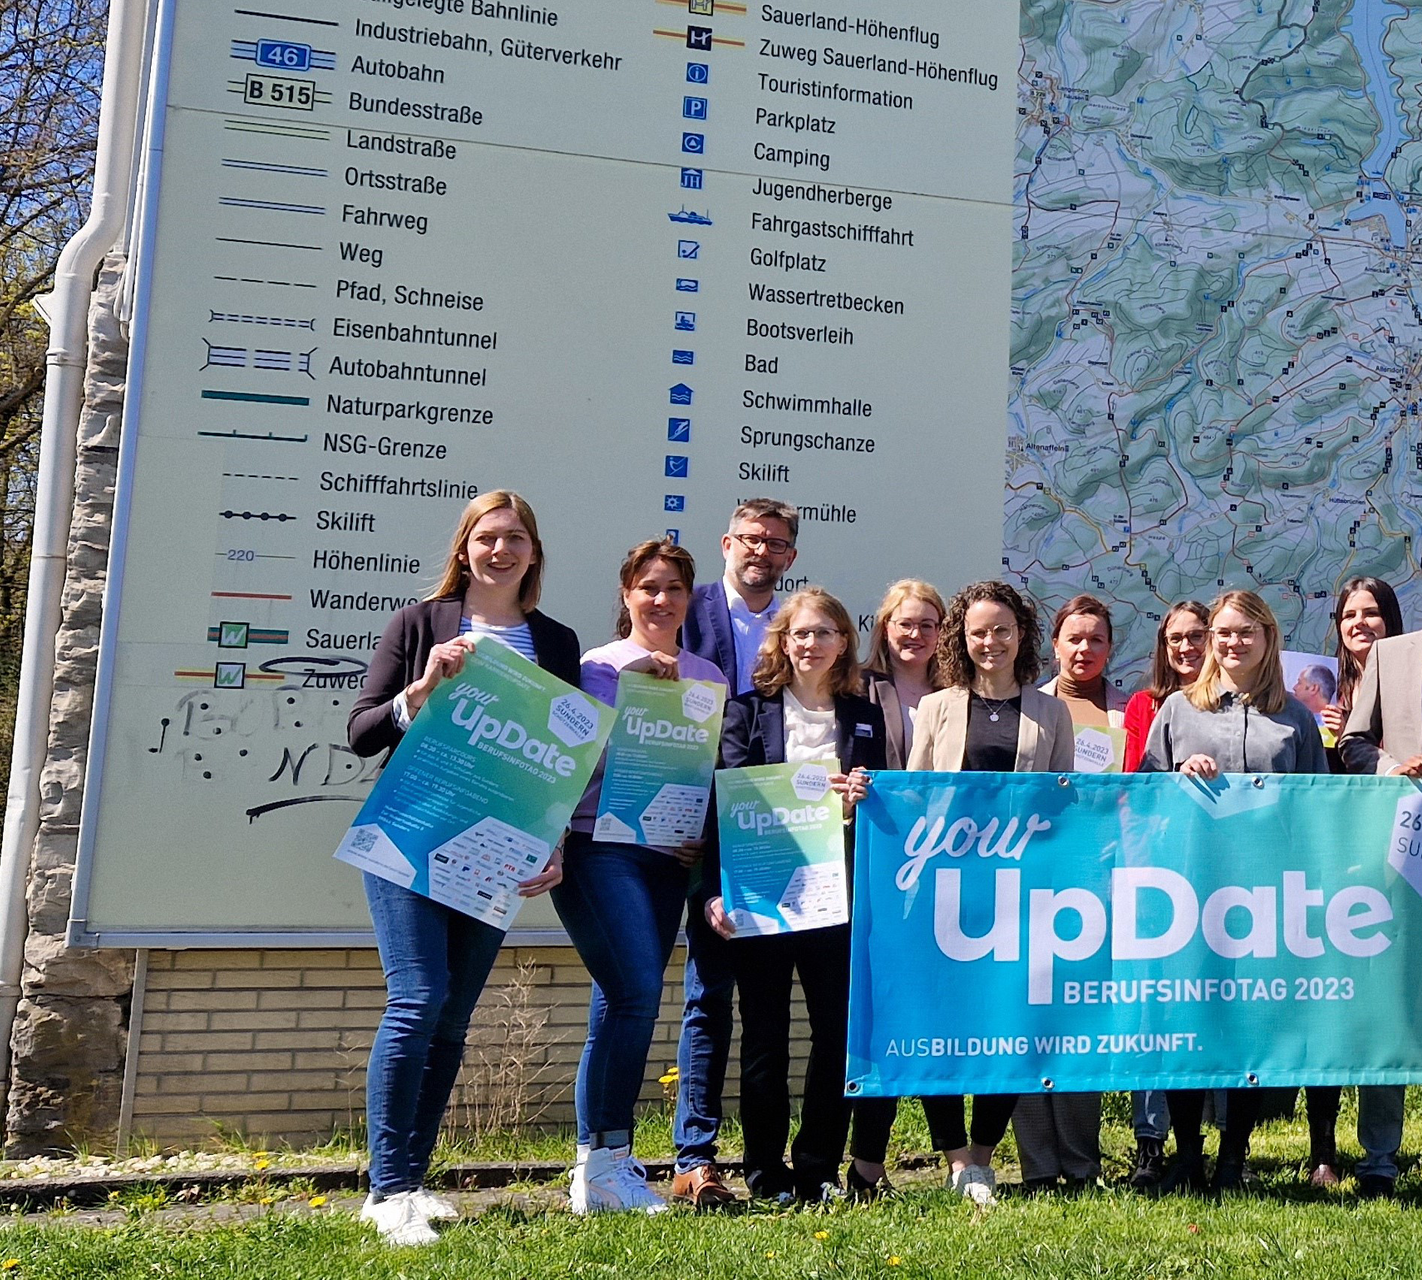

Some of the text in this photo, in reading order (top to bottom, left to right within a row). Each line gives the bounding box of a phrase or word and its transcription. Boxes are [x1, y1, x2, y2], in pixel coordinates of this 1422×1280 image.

[471, 0, 558, 27] Bahnlinie
[761, 5, 940, 49] Sauerland-Höhenflug
[267, 48, 298, 67] 46
[355, 18, 622, 72] Industriebahn, Güterverkehr
[351, 55, 445, 85] Autobahn
[759, 39, 998, 89] Zuweg Sauerland-Höhenflug
[249, 81, 311, 105] B 515
[758, 73, 913, 110] Touristinformation
[349, 92, 483, 126] Bundesstraße
[756, 108, 836, 134] Parkplatz
[346, 130, 457, 160] Landstraße
[754, 142, 830, 171] Camping
[344, 167, 447, 196] Ortsstraße
[752, 178, 892, 211] Jugendherberge
[342, 205, 428, 235] Fahrweg
[751, 213, 914, 247] Fahrgastschifffahrt
[339, 242, 383, 268] Weg
[750, 248, 826, 273] Golfplatz
[337, 280, 484, 312] Pfad, Schneise
[748, 283, 904, 315] Wassertretbecken
[333, 318, 497, 350] Eisenbahntunnel
[747, 319, 854, 345] Bootsverleih
[330, 356, 487, 387] Autobahntunnel
[745, 355, 778, 374] Bad
[327, 395, 494, 426] Naturparkgrenze
[743, 390, 872, 417] Schwimmhalle
[323, 433, 447, 460] NSG-Grenze
[741, 426, 875, 453] Sprungschanze
[319, 471, 479, 500] Schifffahrtslinie
[738, 462, 790, 483] Skilift
[316, 510, 375, 533] Skilift
[227, 549, 254, 561] 220
[313, 550, 420, 575] Höhenlinie
[310, 589, 418, 612] Wanderwe
[306, 628, 382, 650] Sauerla
[302, 668, 368, 690] Zuwe
[448, 681, 499, 707] your
[555, 705, 590, 737] SUNDERN
[560, 699, 594, 730] 26.4.2023
[451, 700, 577, 778] UpDate
[626, 716, 710, 744] UpDate
[476, 741, 557, 784] BERUFSINFOTAG 2023
[738, 805, 830, 836] UpDate
[896, 811, 1050, 891] your
[934, 866, 1394, 1005] UpDate
[1064, 976, 1355, 1005] BERUFSINFOTAG 2023
[886, 1033, 1203, 1058] AUSBILDUNG WIRD ZUKUNFT.
